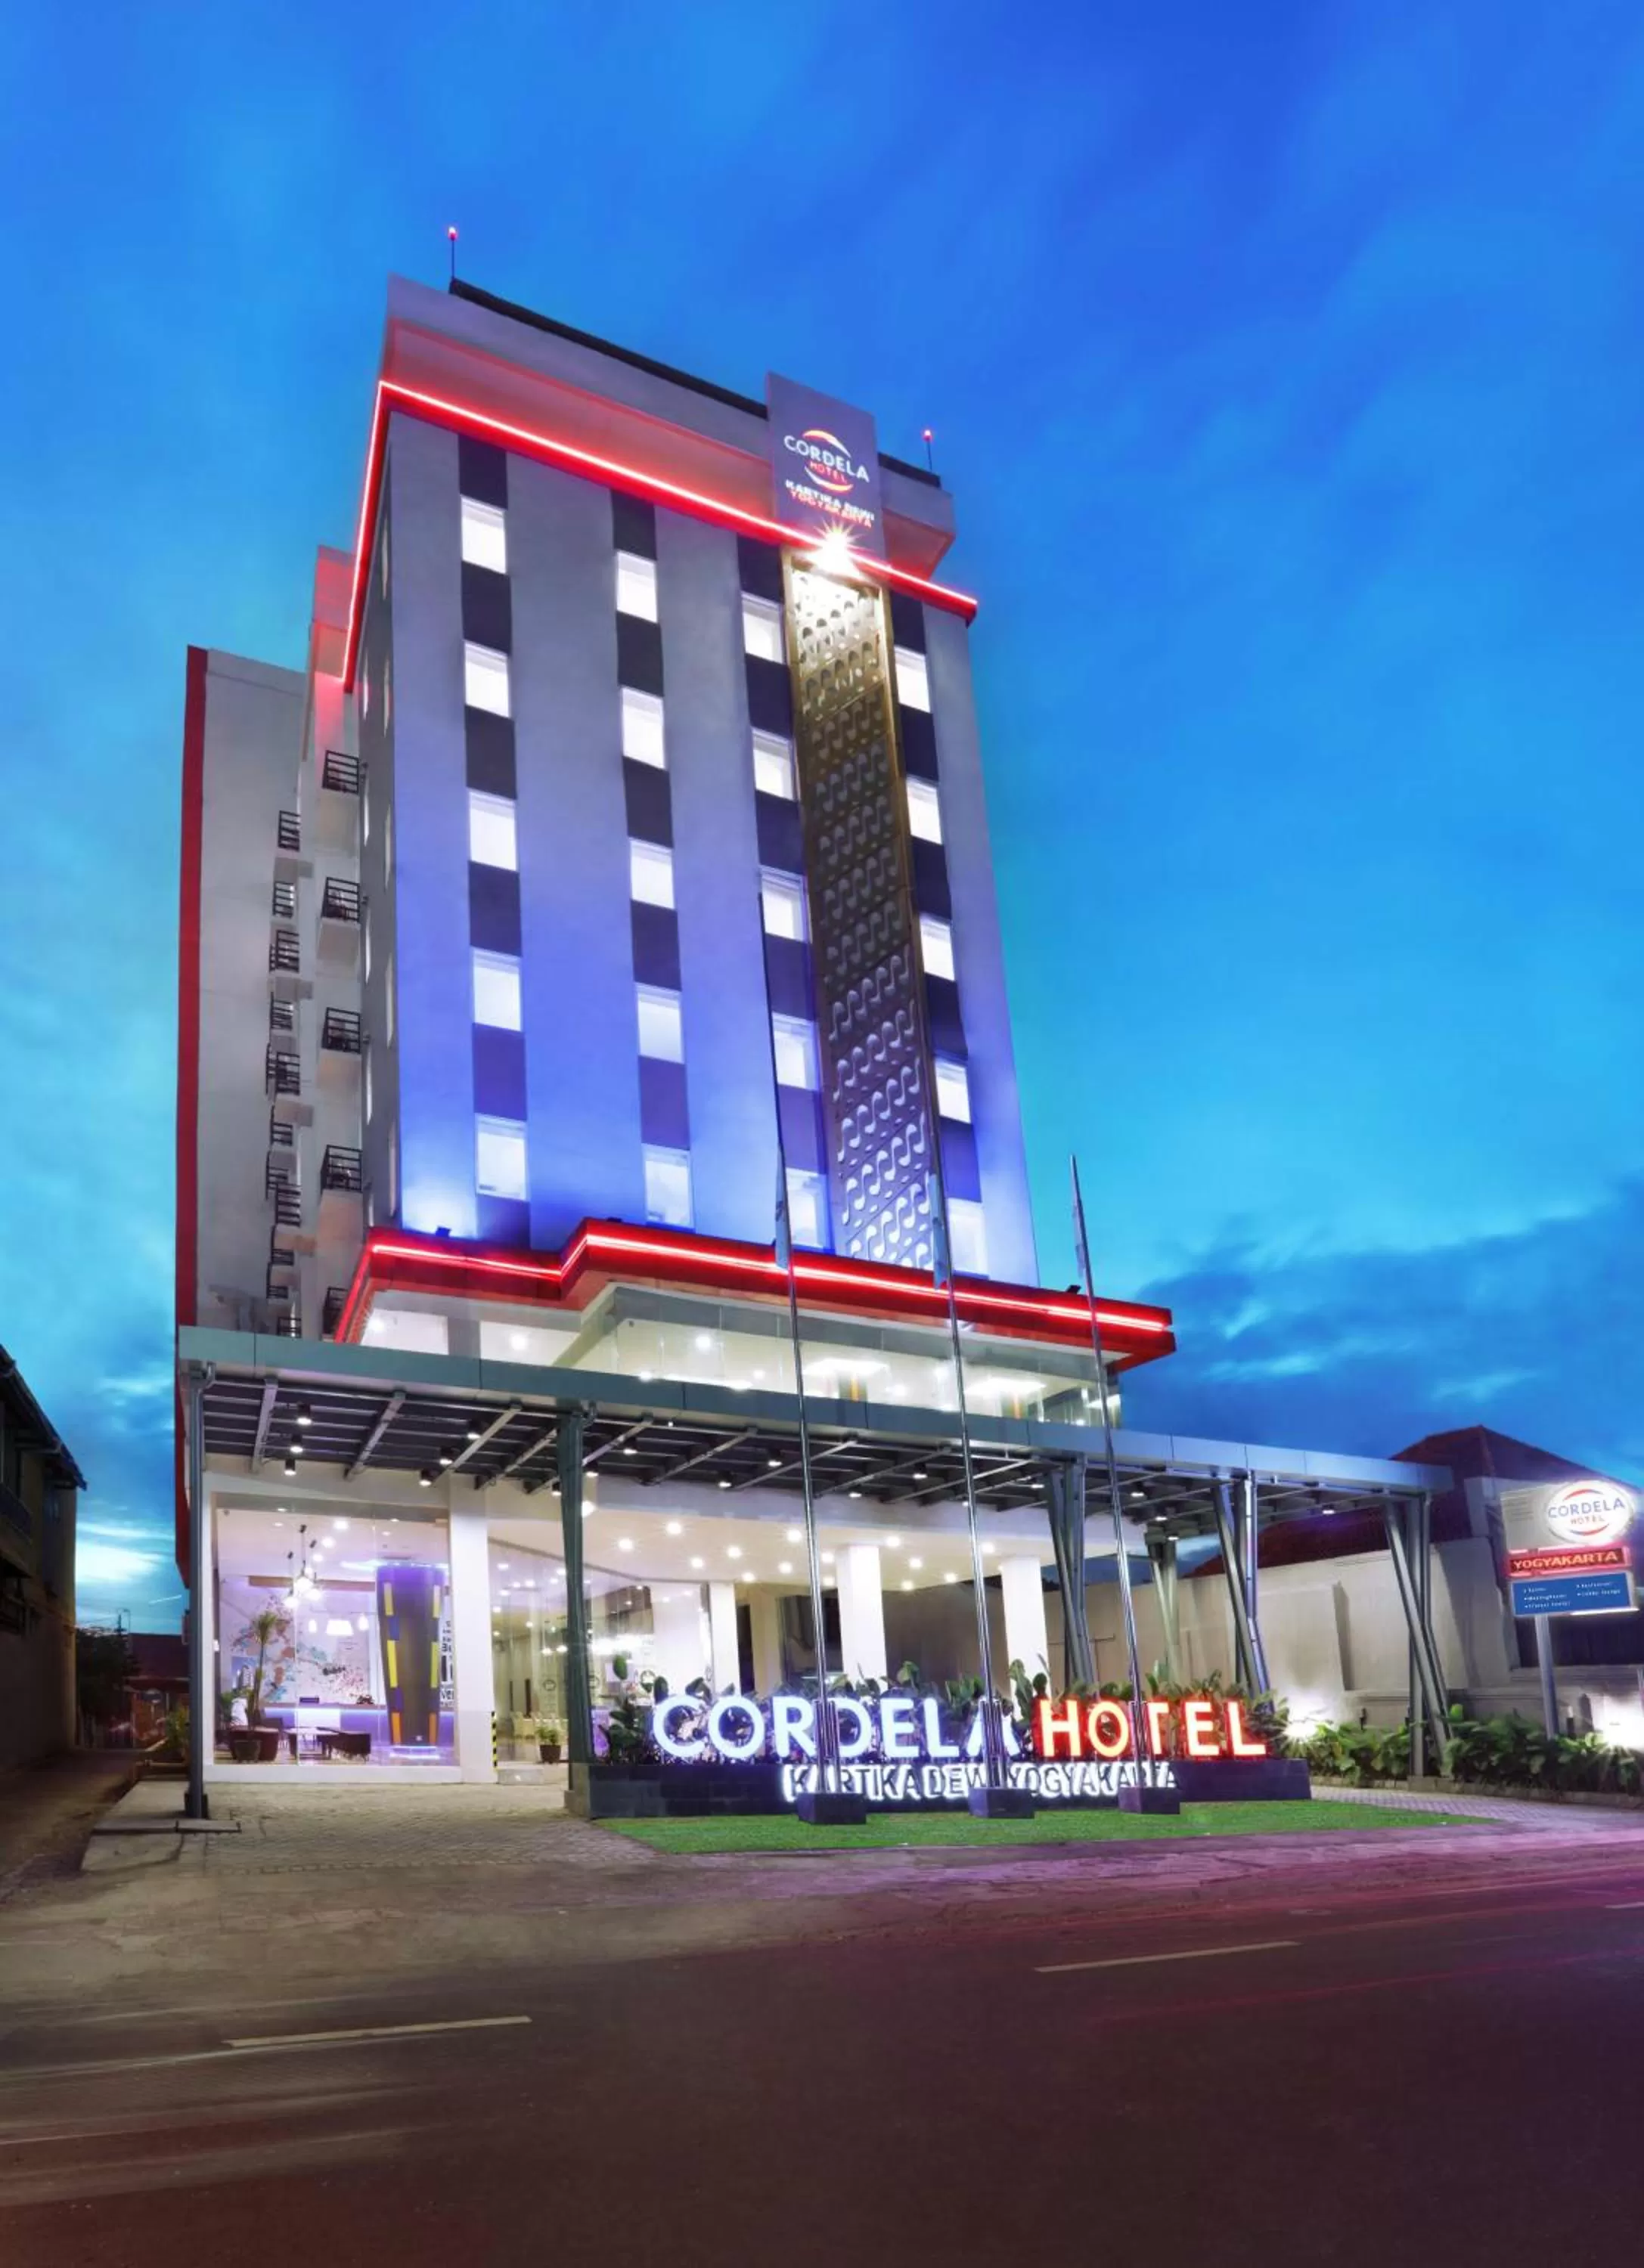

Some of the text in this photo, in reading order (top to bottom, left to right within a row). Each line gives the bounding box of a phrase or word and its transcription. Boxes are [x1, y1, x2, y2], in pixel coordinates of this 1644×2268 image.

[783, 435, 869, 482] CORDELA
[809, 461, 847, 484] HOTEL
[1549, 1498, 1625, 1518] CORDELA
[1571, 1515, 1605, 1525] HOTEL
[1513, 1551, 1618, 1569] YOGYAKARTA
[653, 1696, 1266, 1758] CORDELA HOTEL
[923, 1765, 1000, 1799] DEW
